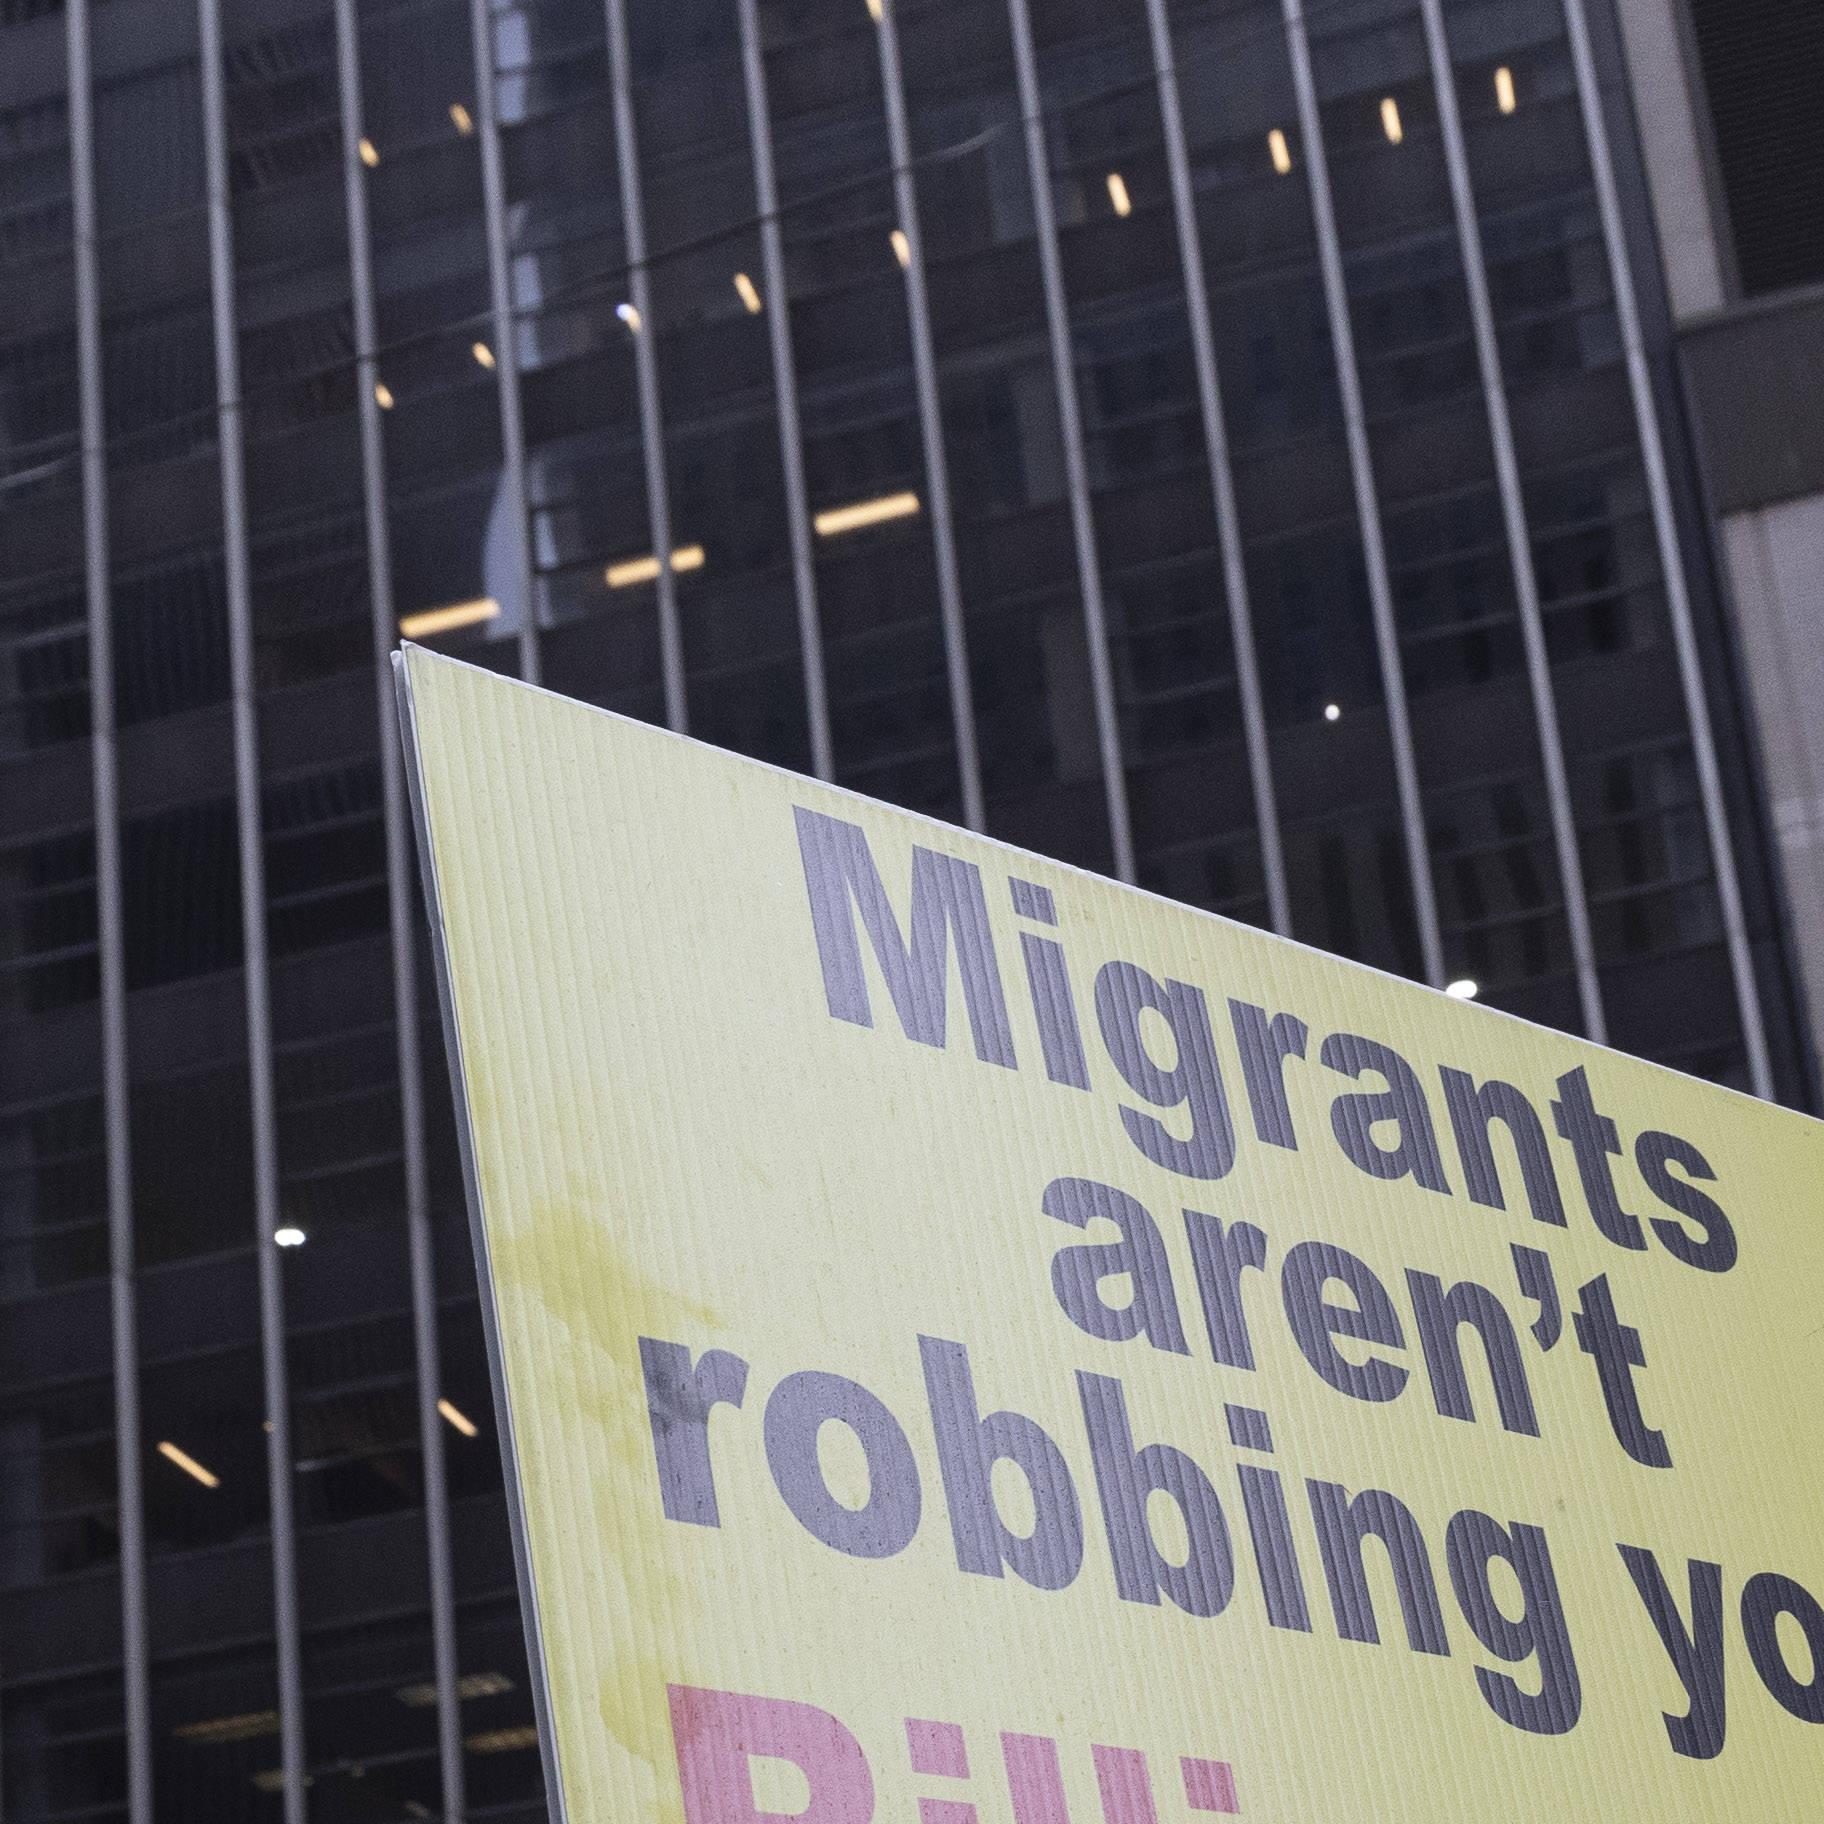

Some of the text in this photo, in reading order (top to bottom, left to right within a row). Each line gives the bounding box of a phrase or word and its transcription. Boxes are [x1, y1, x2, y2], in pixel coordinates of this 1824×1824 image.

[793, 805, 1739, 1274] Migrants
[1040, 1176, 1674, 1470] aren’t
[637, 1334, 1583, 1738] robbing
